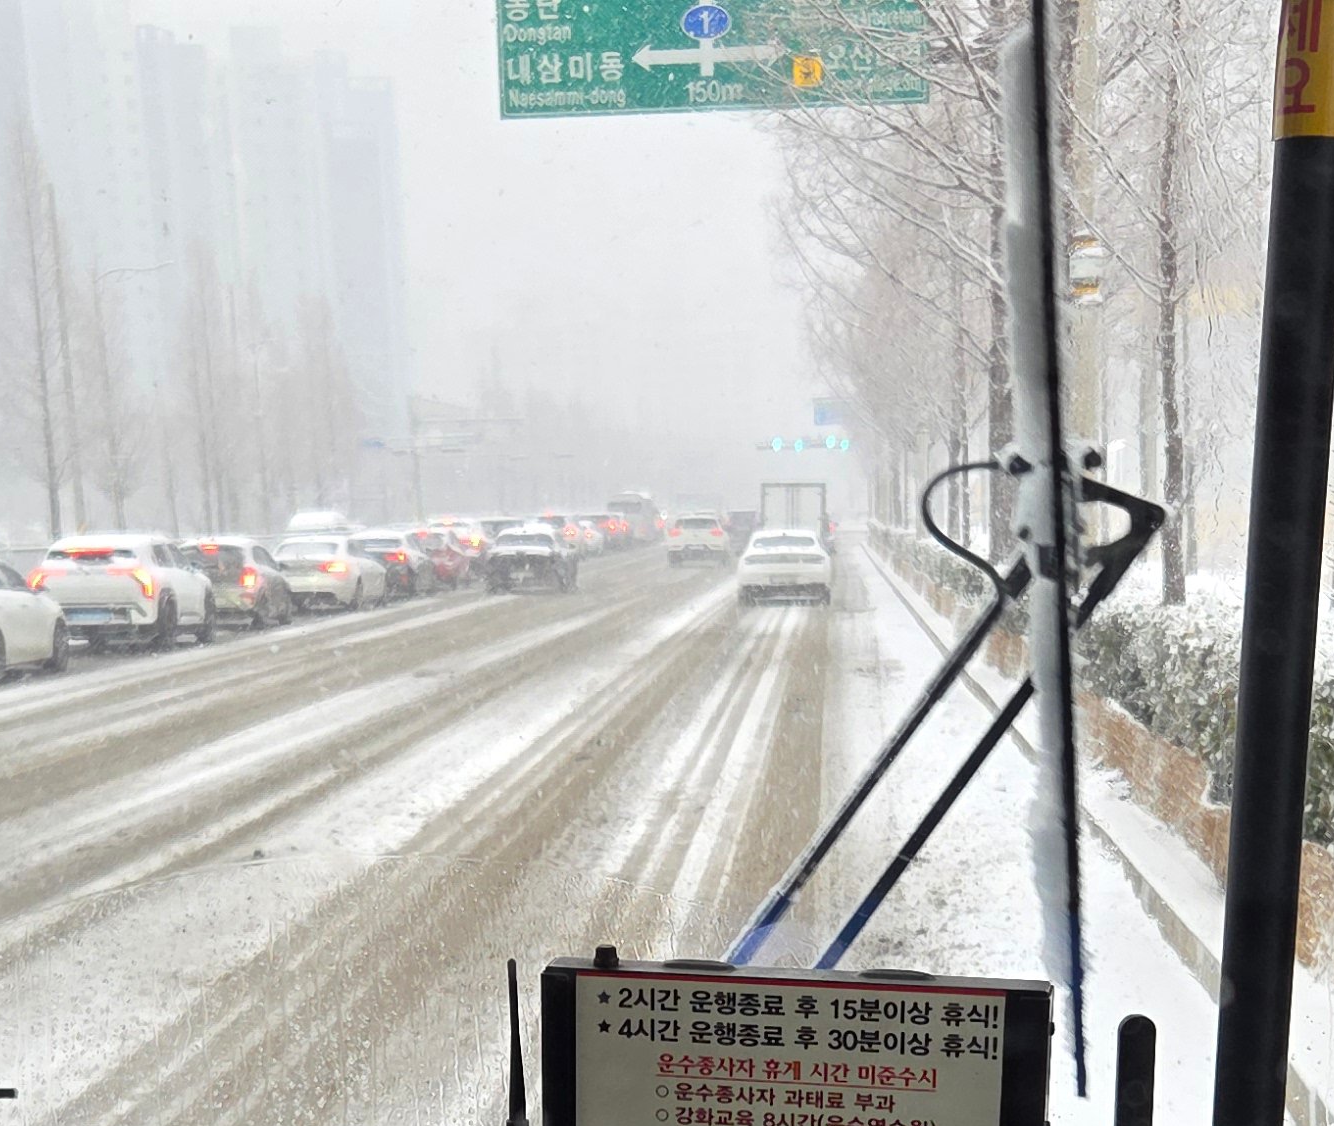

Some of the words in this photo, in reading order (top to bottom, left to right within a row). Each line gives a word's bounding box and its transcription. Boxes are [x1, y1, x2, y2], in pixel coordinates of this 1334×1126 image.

[503, 23, 572, 46] Dongtan
[506, 51, 626, 86] 내삼미동
[683, 79, 744, 103] 150m
[618, 987, 681, 1012] 2시간
[689, 990, 786, 1016] 운행종료
[794, 995, 819, 1019] 후
[830, 998, 933, 1025] 15분이상
[940, 1002, 999, 1029] 휴식!
[618, 1018, 681, 1042] 4시간
[689, 1020, 786, 1047] 운행종료
[794, 1026, 819, 1050] 후
[828, 1029, 933, 1056] 30분이상
[940, 1033, 999, 1060] 휴식!
[657, 1053, 756, 1078] 운수종사자
[762, 1059, 802, 1081] 휴게
[810, 1062, 850, 1083] 시간
[857, 1064, 938, 1089] 미준수시
[674, 1083, 776, 1107] 운수종사자
[784, 1090, 846, 1110] 과태료
[854, 1093, 896, 1114] 부과
